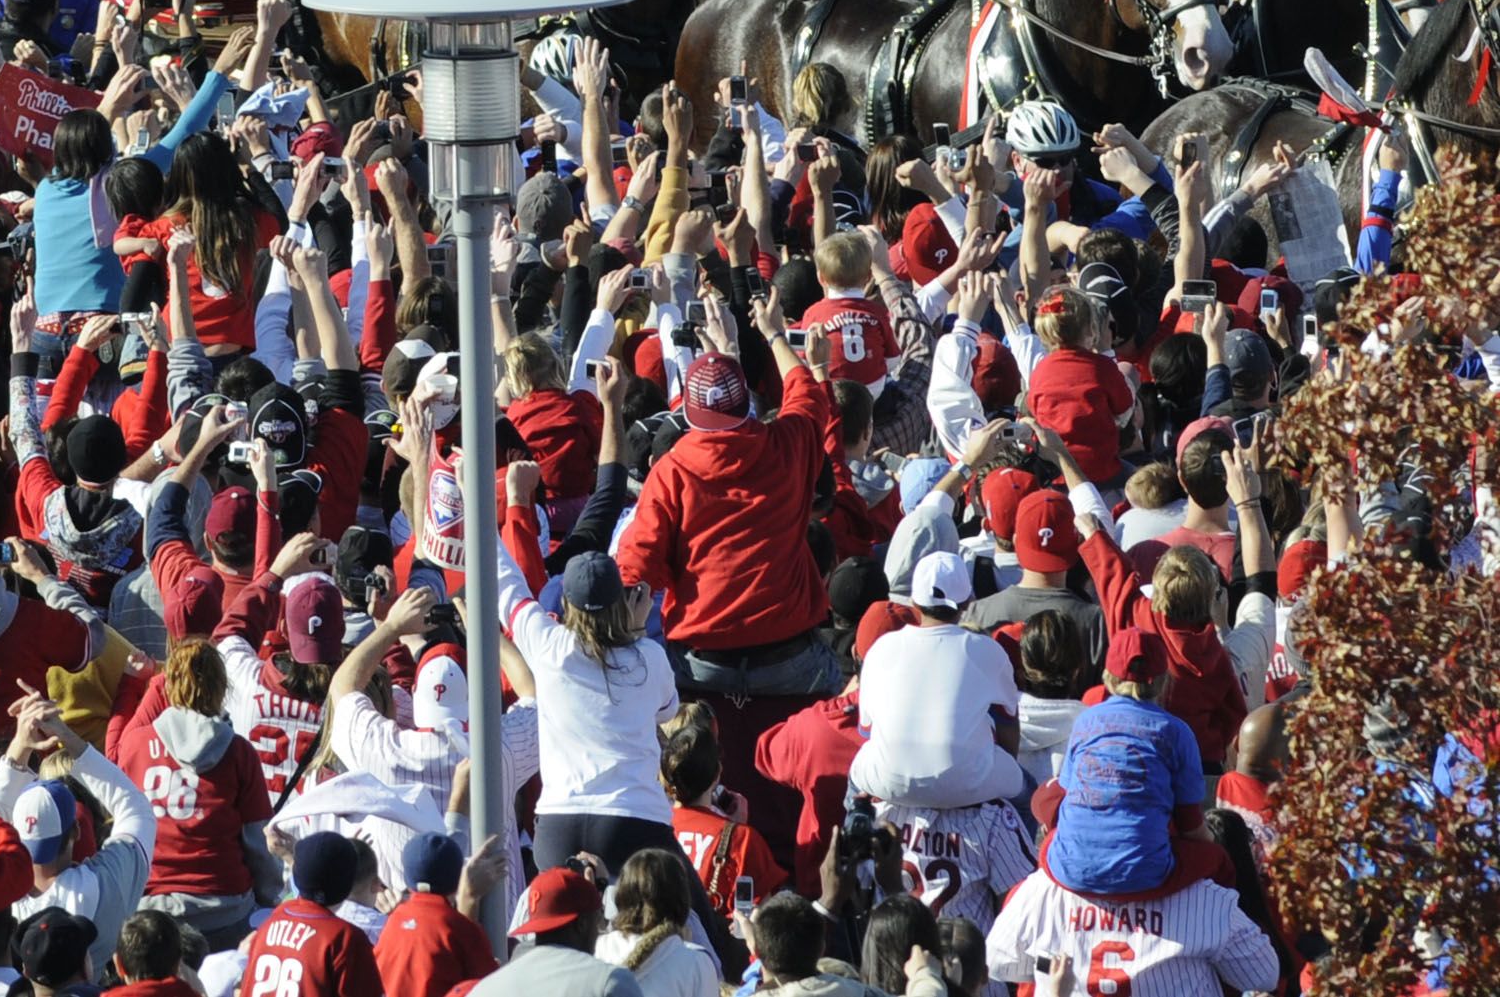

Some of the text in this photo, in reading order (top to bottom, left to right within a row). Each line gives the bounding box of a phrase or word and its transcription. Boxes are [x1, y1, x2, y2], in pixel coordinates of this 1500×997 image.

[14, 116, 55, 150] Pha
[935, 248, 948, 264] P
[1040, 528, 1054, 547] P
[308, 615, 323, 634] P
[433, 683, 446, 702] P
[25, 816, 38, 835] P
[1068, 905, 1164, 938] HOWARD
[265, 919, 317, 952] UTLEY
[1086, 939, 1136, 997] 6
